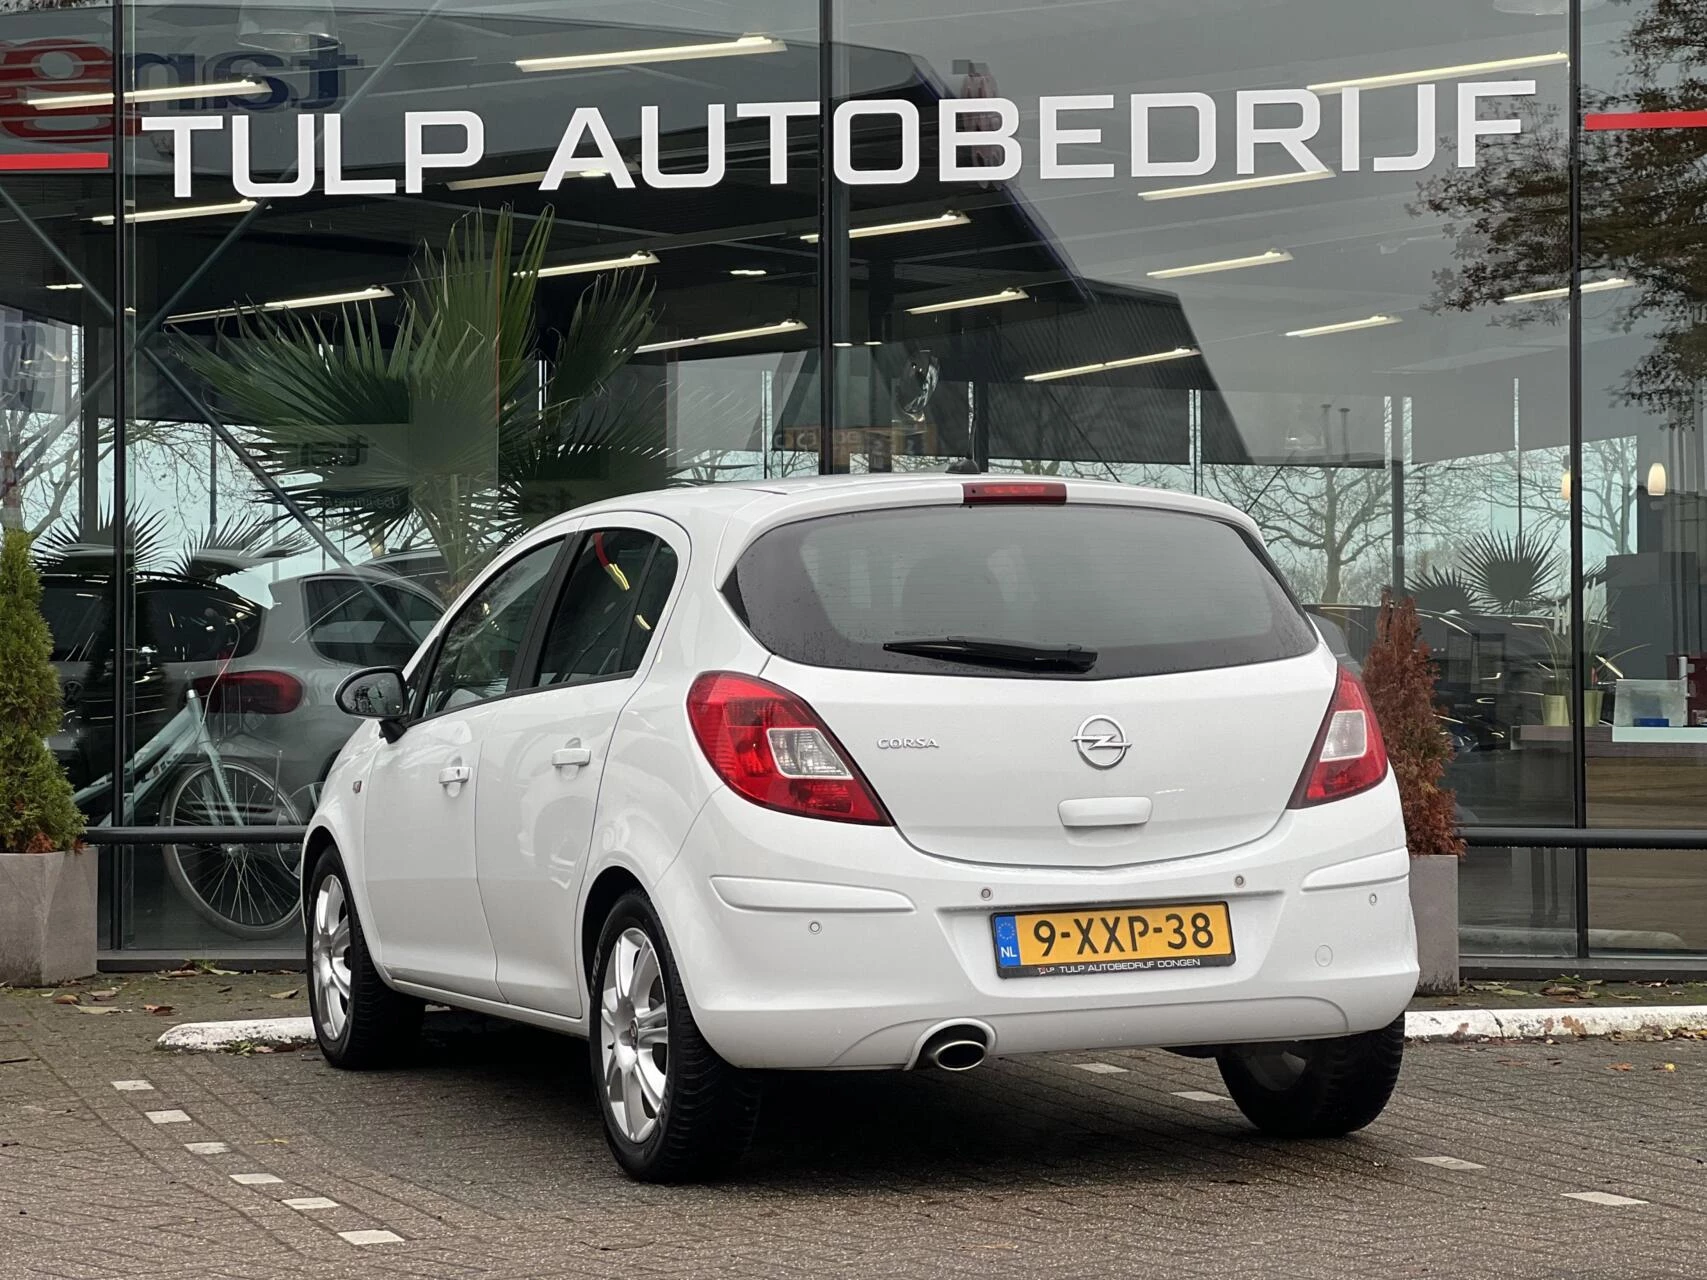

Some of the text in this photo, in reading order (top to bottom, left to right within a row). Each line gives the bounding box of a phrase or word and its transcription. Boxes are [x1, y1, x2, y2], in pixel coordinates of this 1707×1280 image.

[141, 79, 1537, 198] TULP AUTOBEDRIJF
[877, 737, 940, 750] CORSA
[1033, 912, 1214, 958] 9-XXP-38
[1000, 946, 1017, 958] NL
[1059, 958, 1201, 973] TULP AUTOBEDRIJF DONGEN
